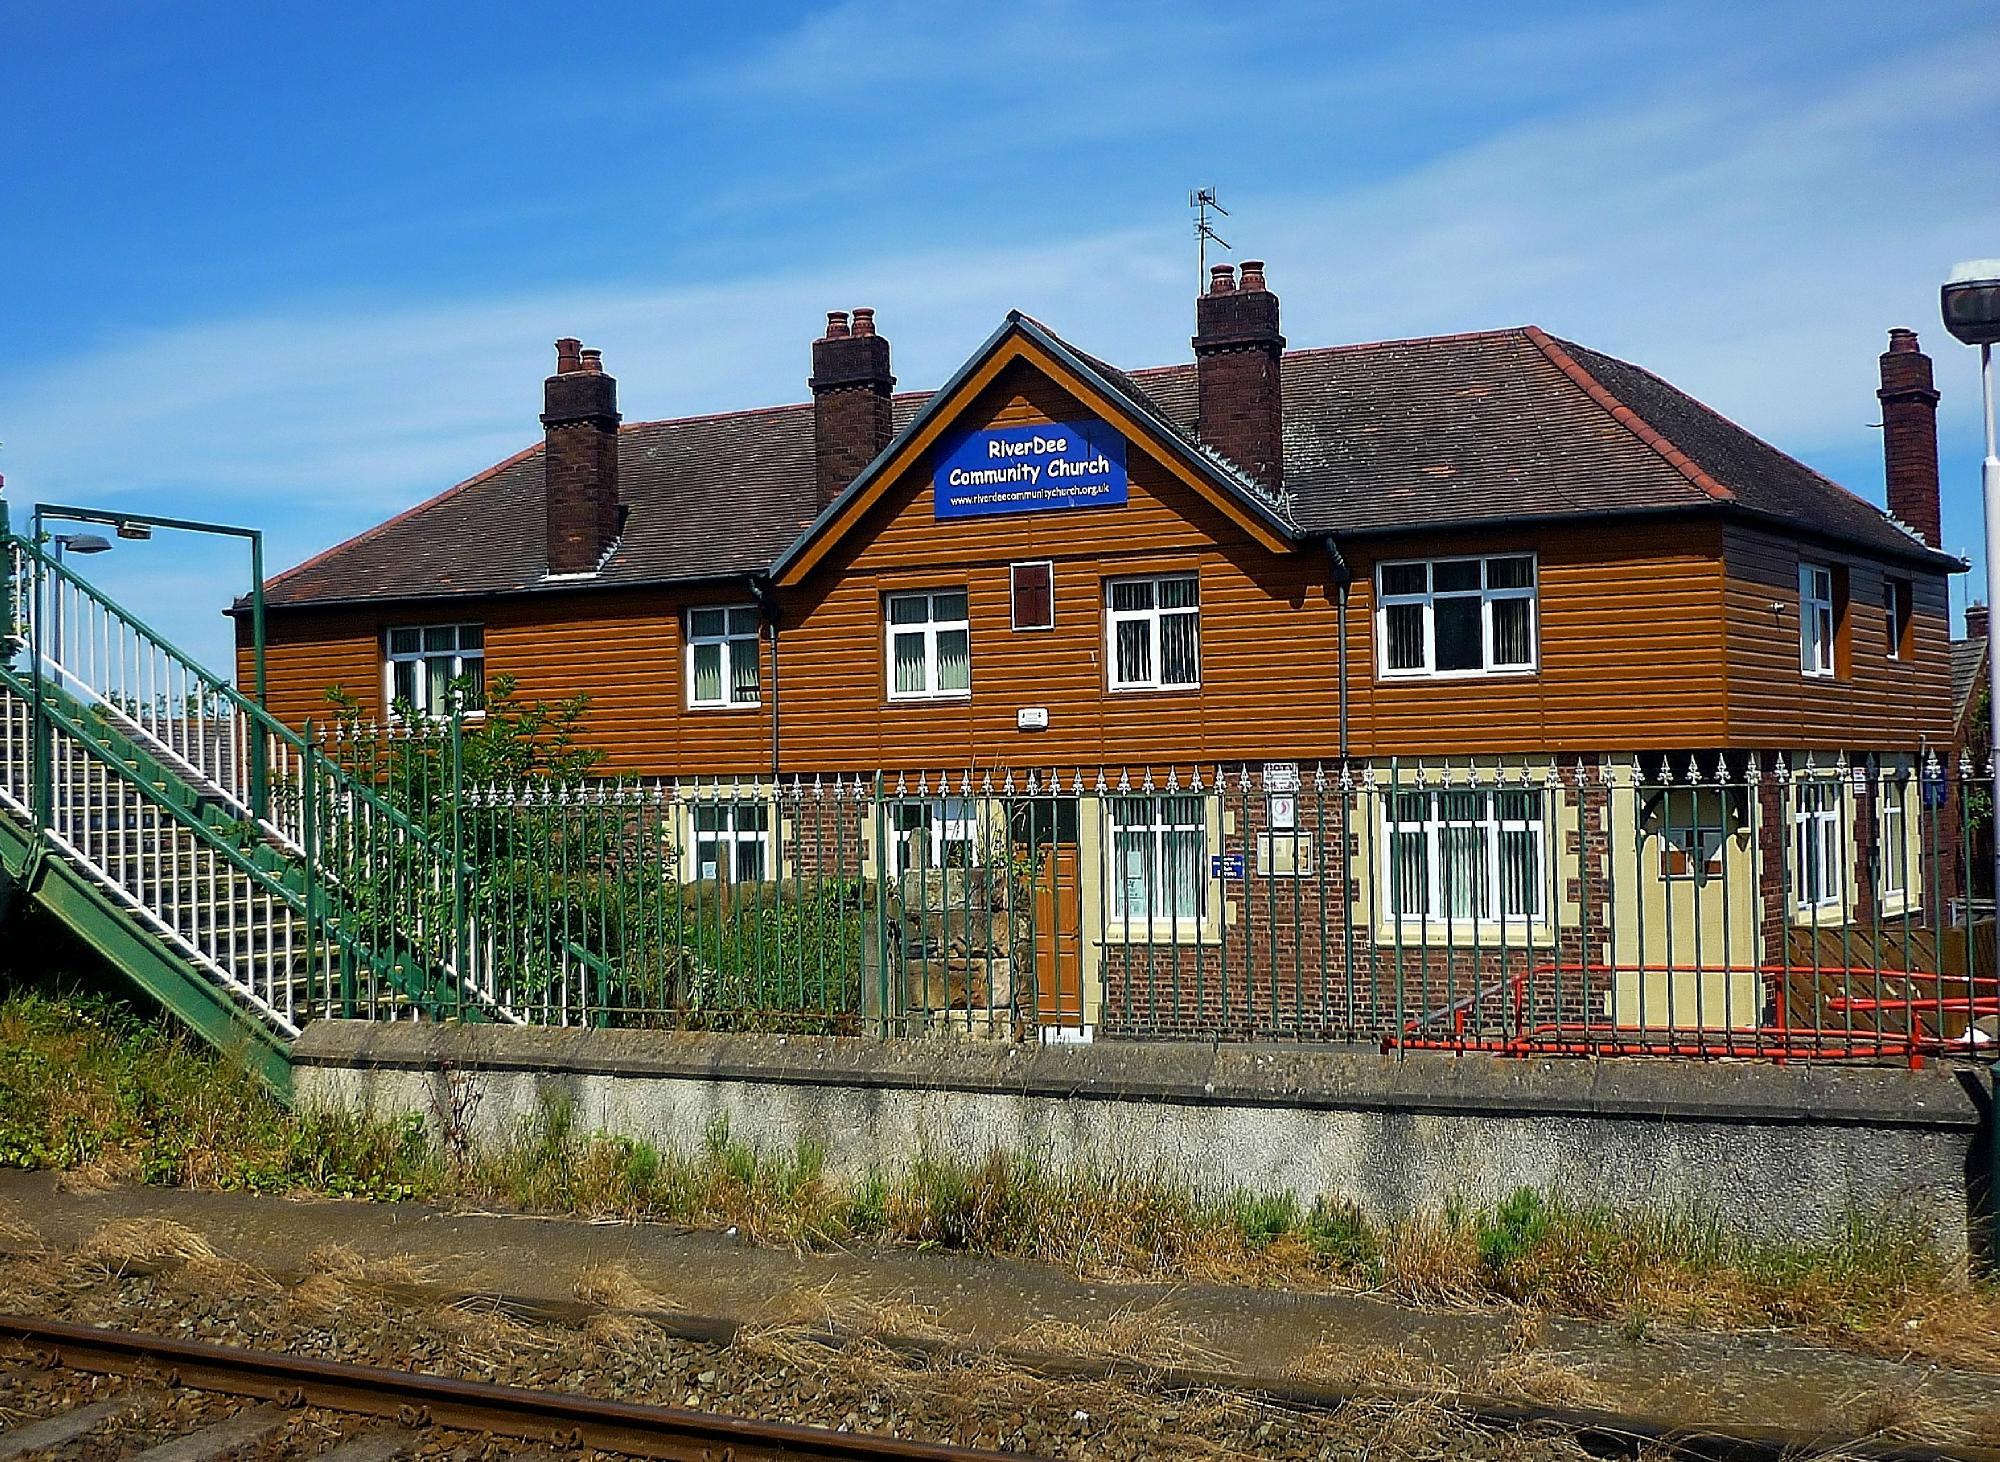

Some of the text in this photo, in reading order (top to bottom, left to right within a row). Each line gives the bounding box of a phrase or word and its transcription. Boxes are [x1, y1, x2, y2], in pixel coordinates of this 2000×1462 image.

[989, 436, 1067, 458] RiverDee
[949, 455, 1110, 486] Community Church
[950, 483, 1110, 506] www.riverdeecommunitychurch.org.uk
